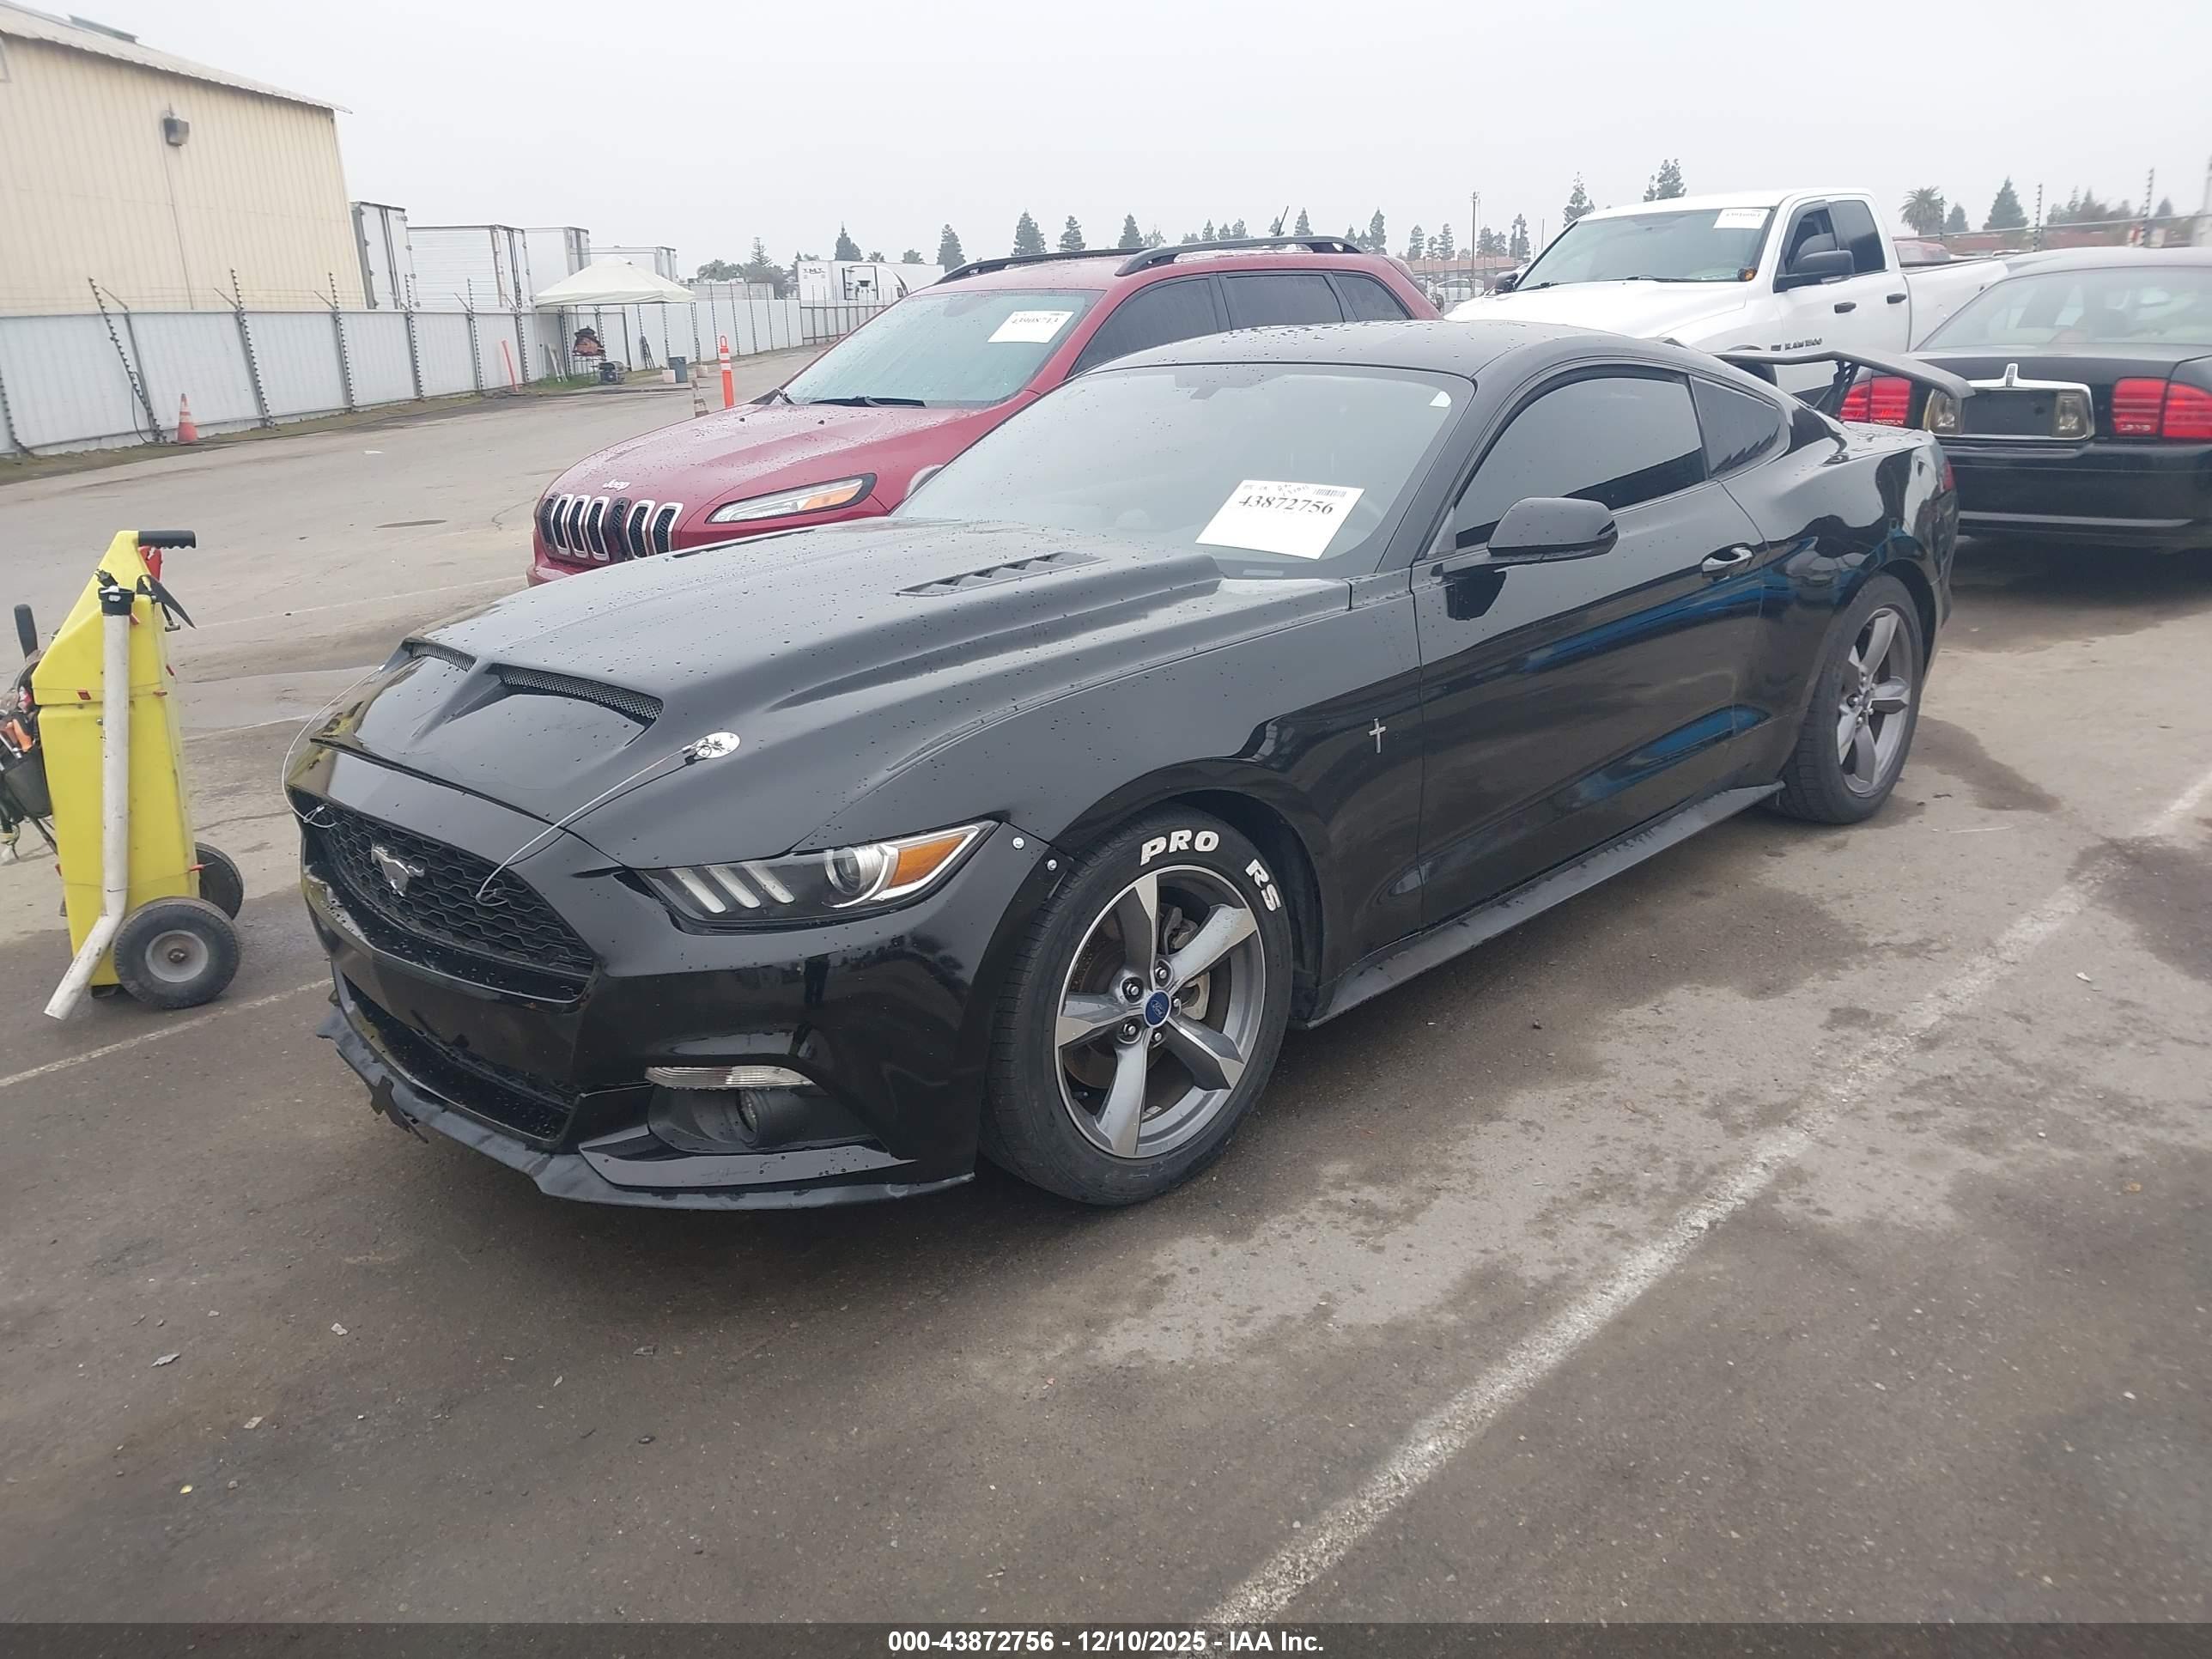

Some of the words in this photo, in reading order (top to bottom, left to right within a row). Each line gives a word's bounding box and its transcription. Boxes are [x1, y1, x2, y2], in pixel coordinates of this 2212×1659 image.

[1238, 495, 1335, 515] 43872756
[1139, 830, 1219, 866] PRO
[1245, 859, 1282, 912] RS
